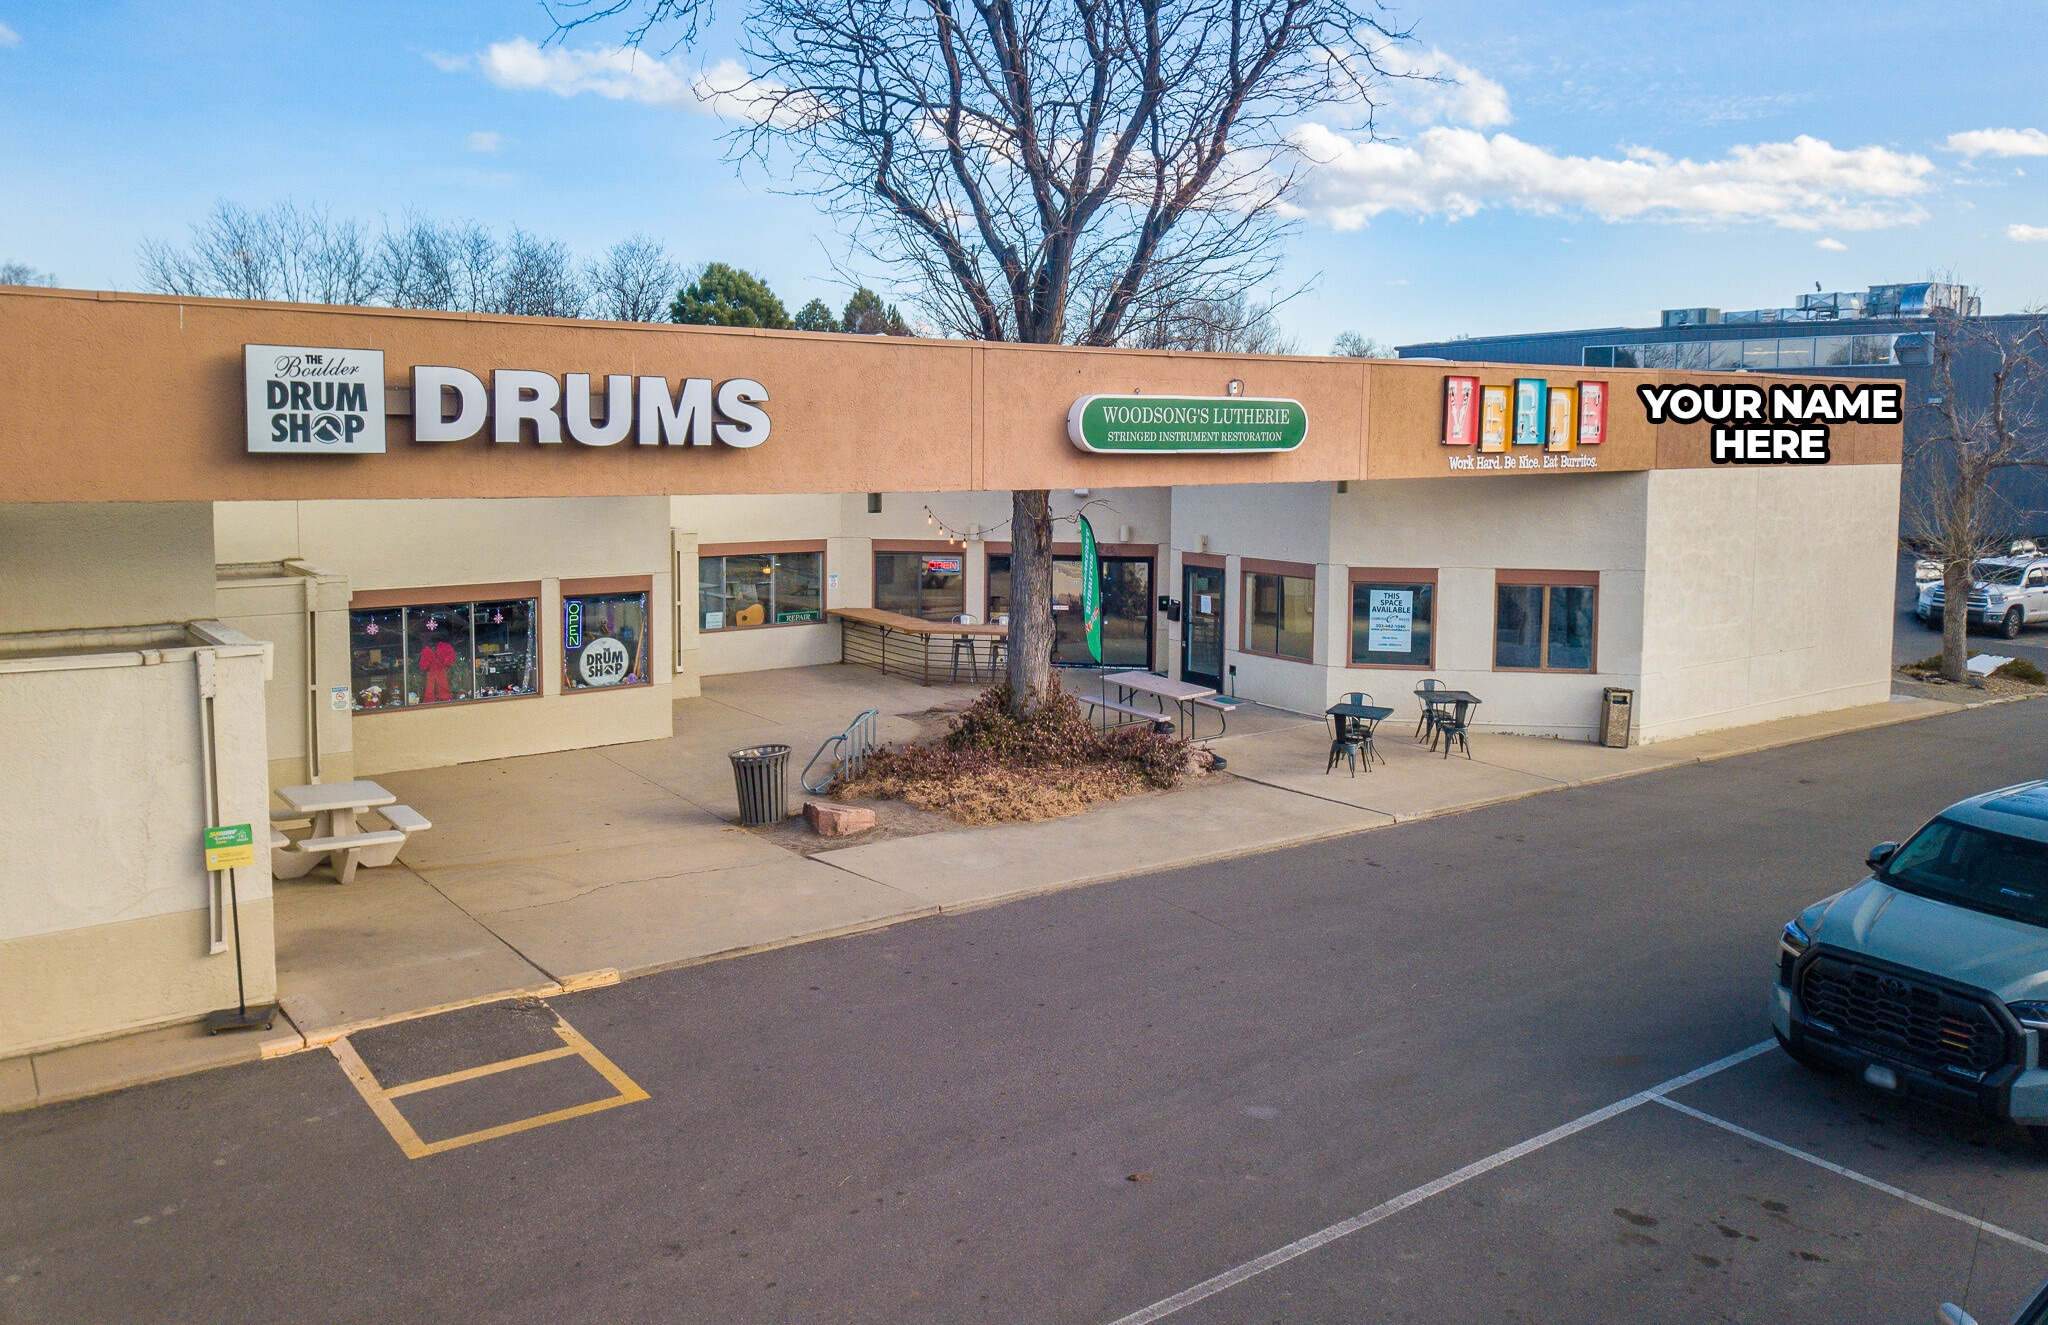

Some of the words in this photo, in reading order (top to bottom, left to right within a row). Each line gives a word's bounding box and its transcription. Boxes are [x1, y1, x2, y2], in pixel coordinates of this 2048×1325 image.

[274, 356, 360, 378] Boulder
[305, 354, 323, 364] THE
[267, 380, 368, 411] DRUM
[413, 365, 772, 447] DRUMS
[1447, 380, 1603, 448] VERDE
[1103, 406, 1209, 424] WOODSONG'S
[1213, 407, 1290, 425] LUTHERIE
[271, 413, 365, 444] SHOP
[1107, 431, 1157, 442] STRINGED
[1159, 431, 1219, 442] INSTRUMENT
[1221, 431, 1283, 442] RESTORATION
[1449, 455, 1475, 470] Work
[1476, 456, 1502, 470] Hard.
[1504, 456, 1516, 469] Be
[1519, 455, 1540, 469] Nice.
[1543, 456, 1558, 469] Eat
[1560, 454, 1598, 468] Burritos.
[928, 561, 957, 569] OPEN
[569, 603, 580, 646] OPEN
[786, 613, 811, 621] REPAIR
[586, 651, 623, 666] DRUM
[588, 663, 623, 677] SHOP
